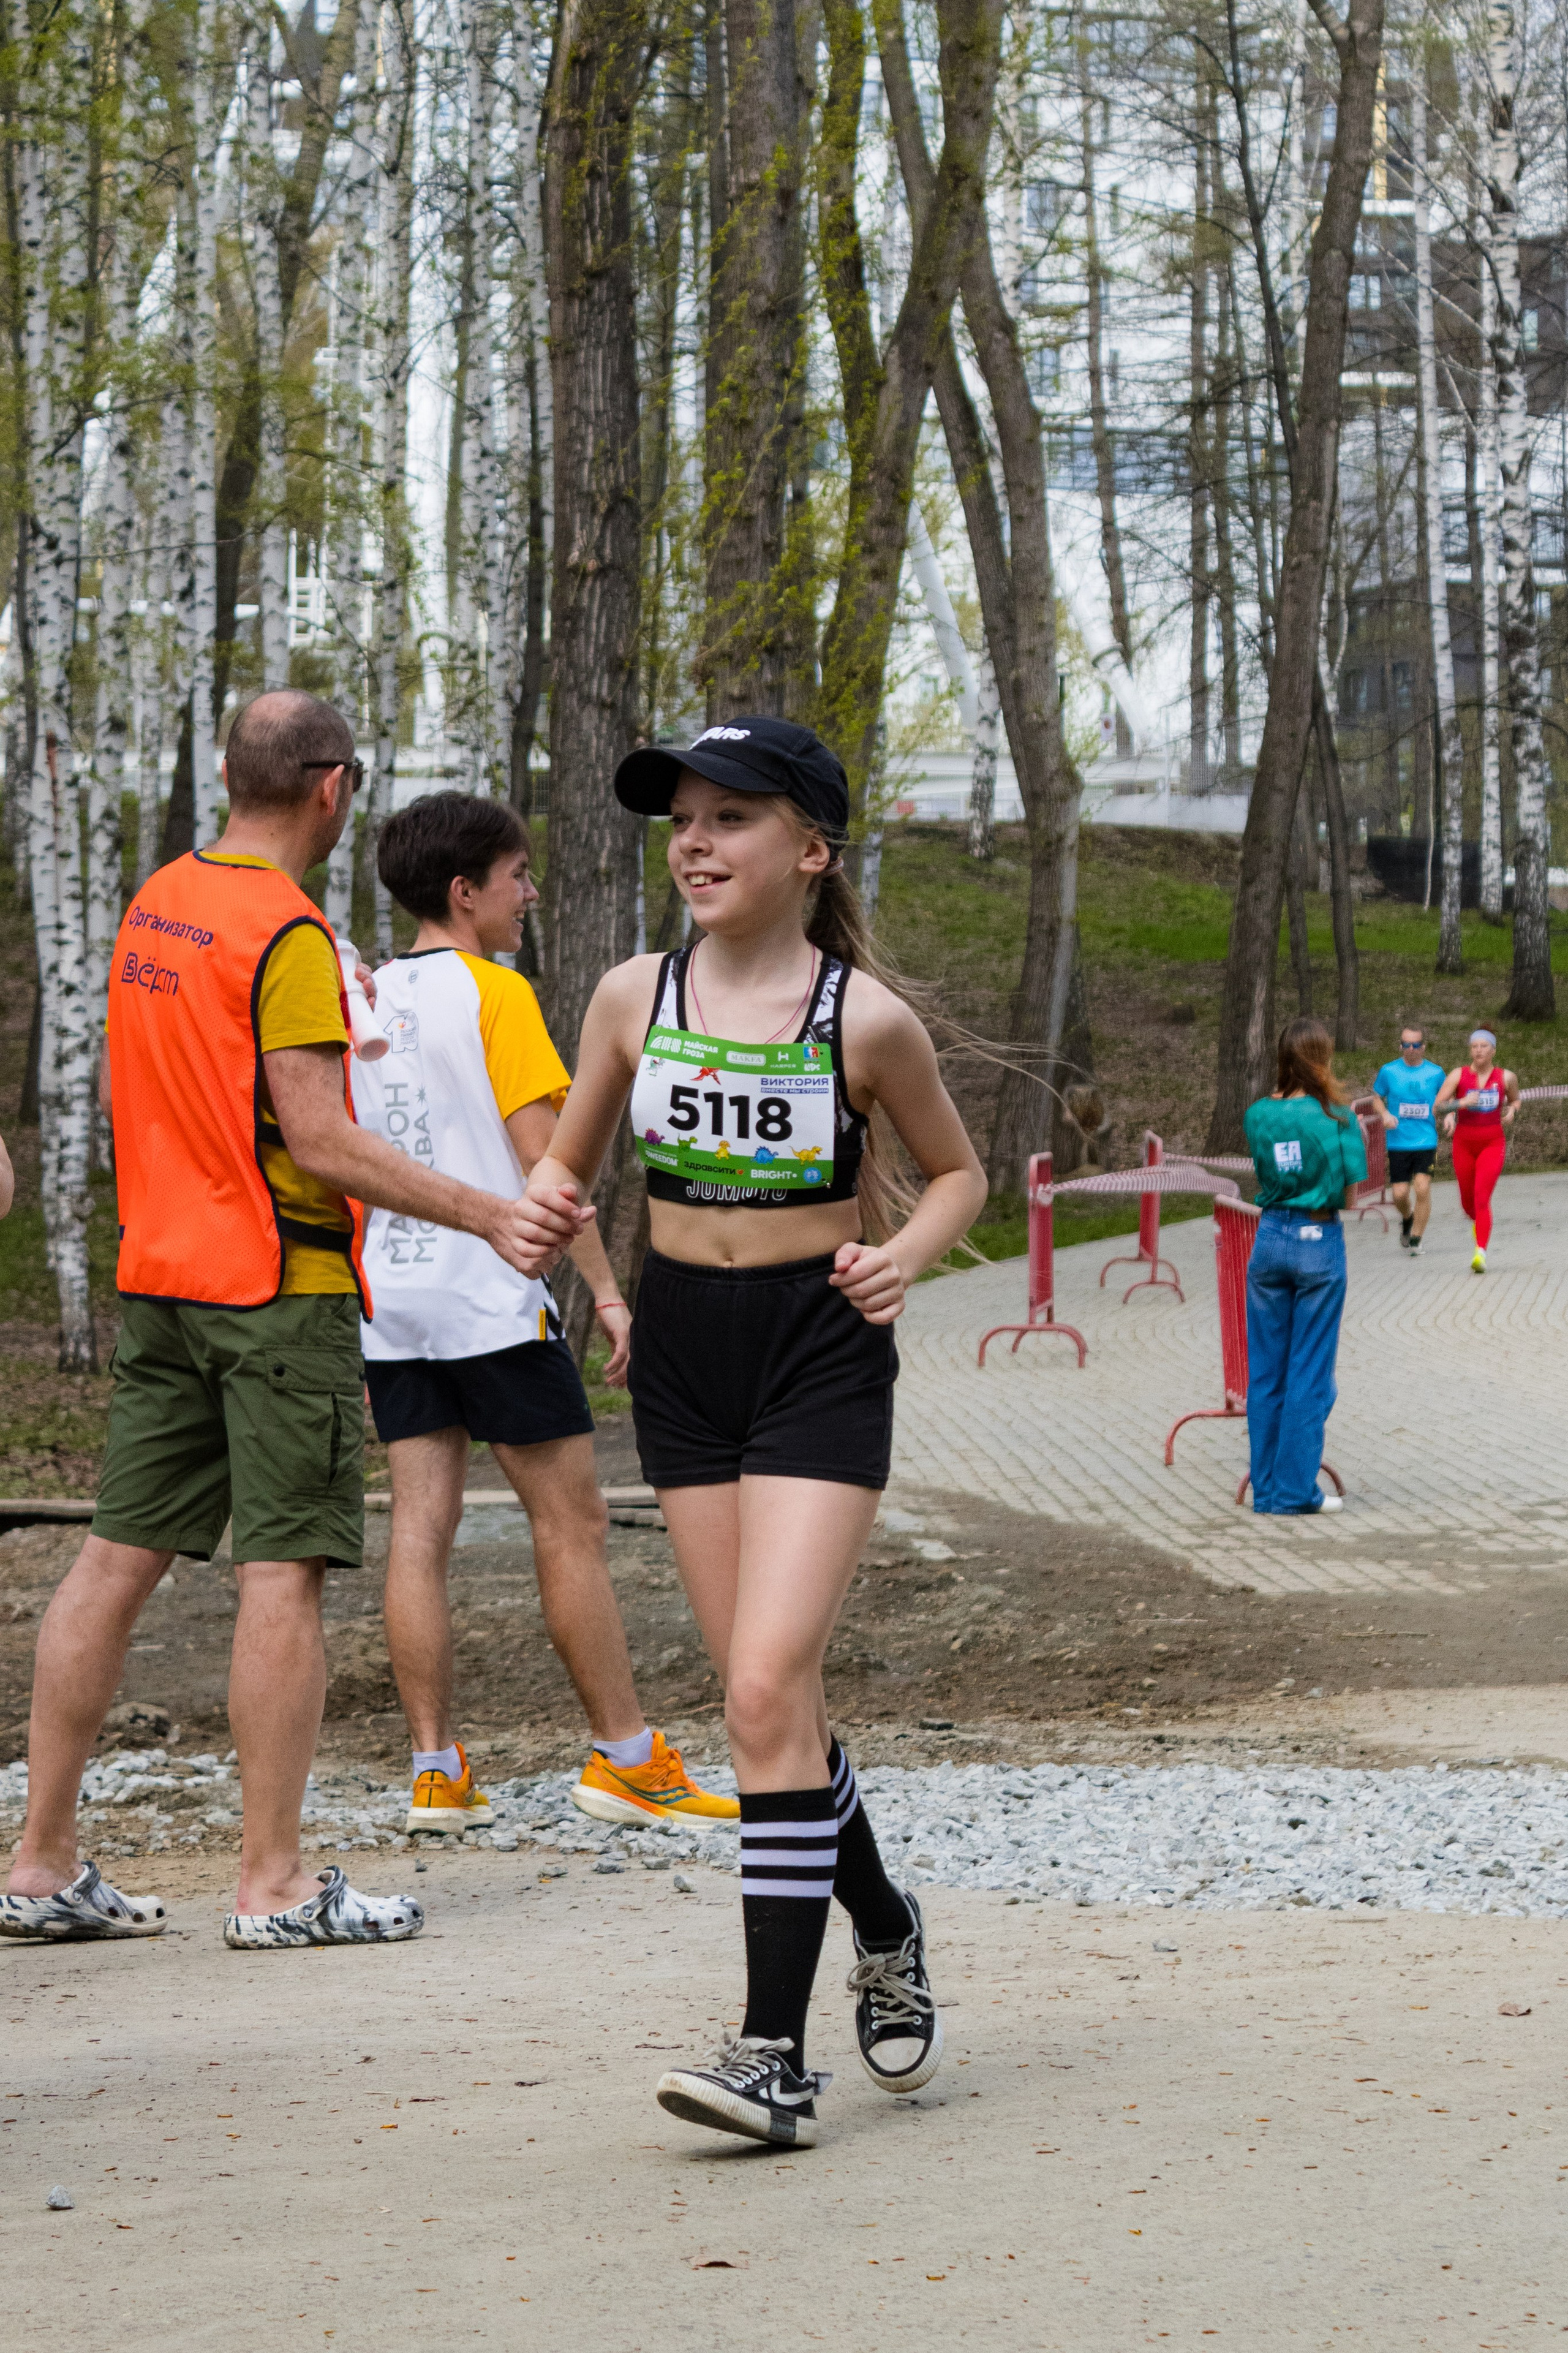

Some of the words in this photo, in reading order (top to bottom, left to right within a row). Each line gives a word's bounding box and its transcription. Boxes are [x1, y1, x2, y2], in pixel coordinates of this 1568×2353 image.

[129, 905, 214, 949] Организатор
[682, 1048, 705, 1059] ГРОЗА
[684, 1040, 718, 1054] МАЙСКАЯ
[761, 1078, 829, 1086] ВИКТОРИЯ
[666, 1084, 793, 1142] 5118
[684, 1161, 736, 1175] здравсити
